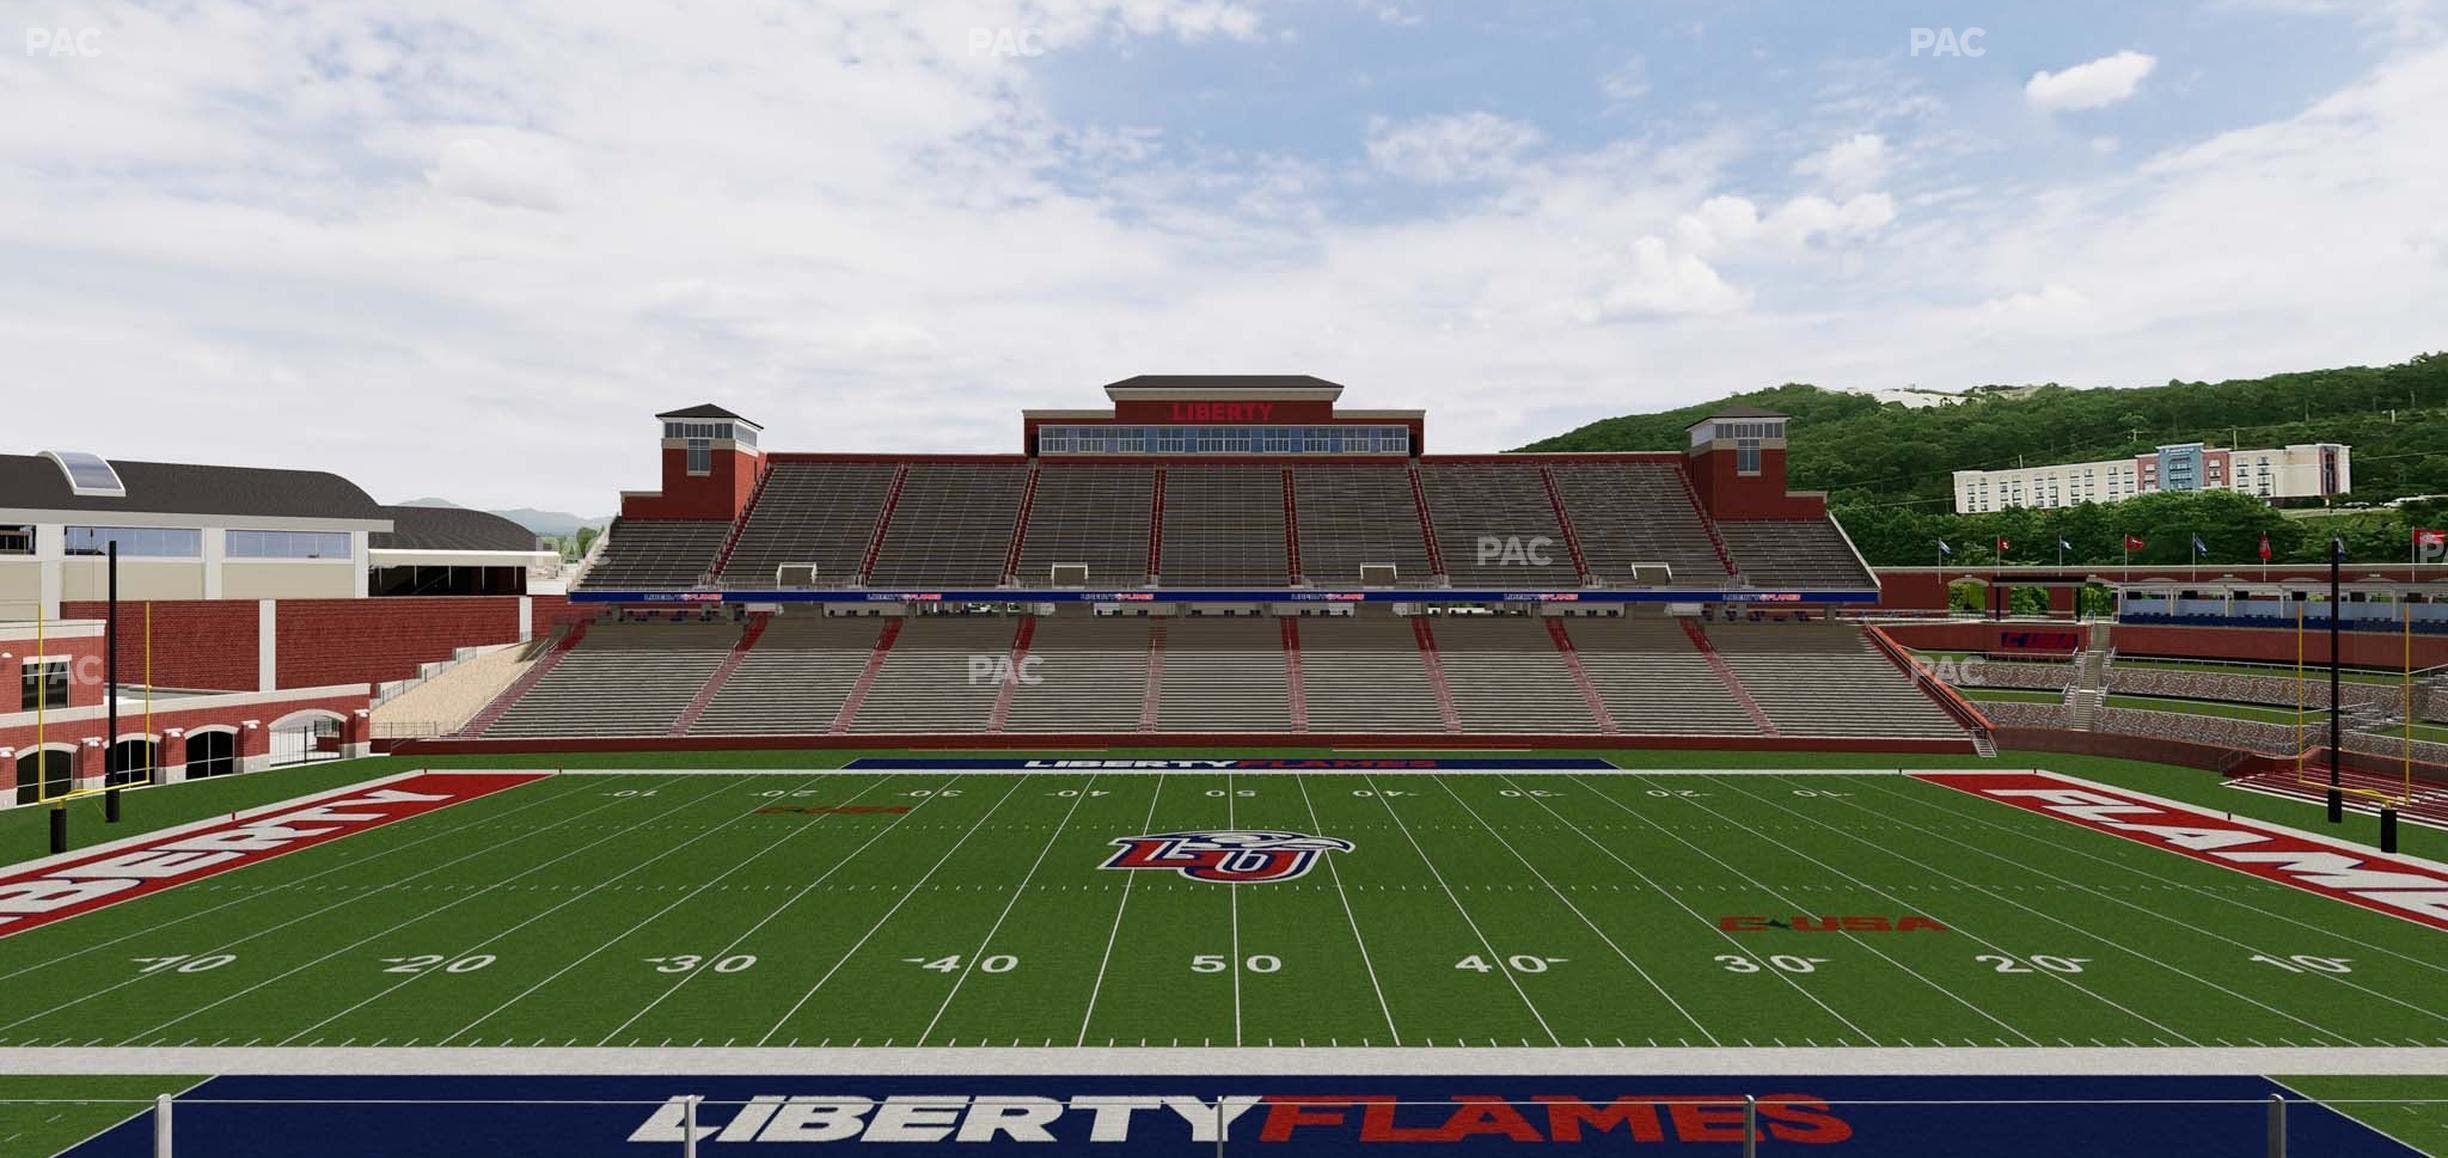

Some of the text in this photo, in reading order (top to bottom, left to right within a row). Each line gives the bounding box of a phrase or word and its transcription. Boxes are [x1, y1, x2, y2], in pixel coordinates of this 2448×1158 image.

[1172, 402, 1273, 421] LIBERTY
[0, 789, 456, 925] BERTY
[627, 1094, 1854, 1144] LIBERTY FLAMES
